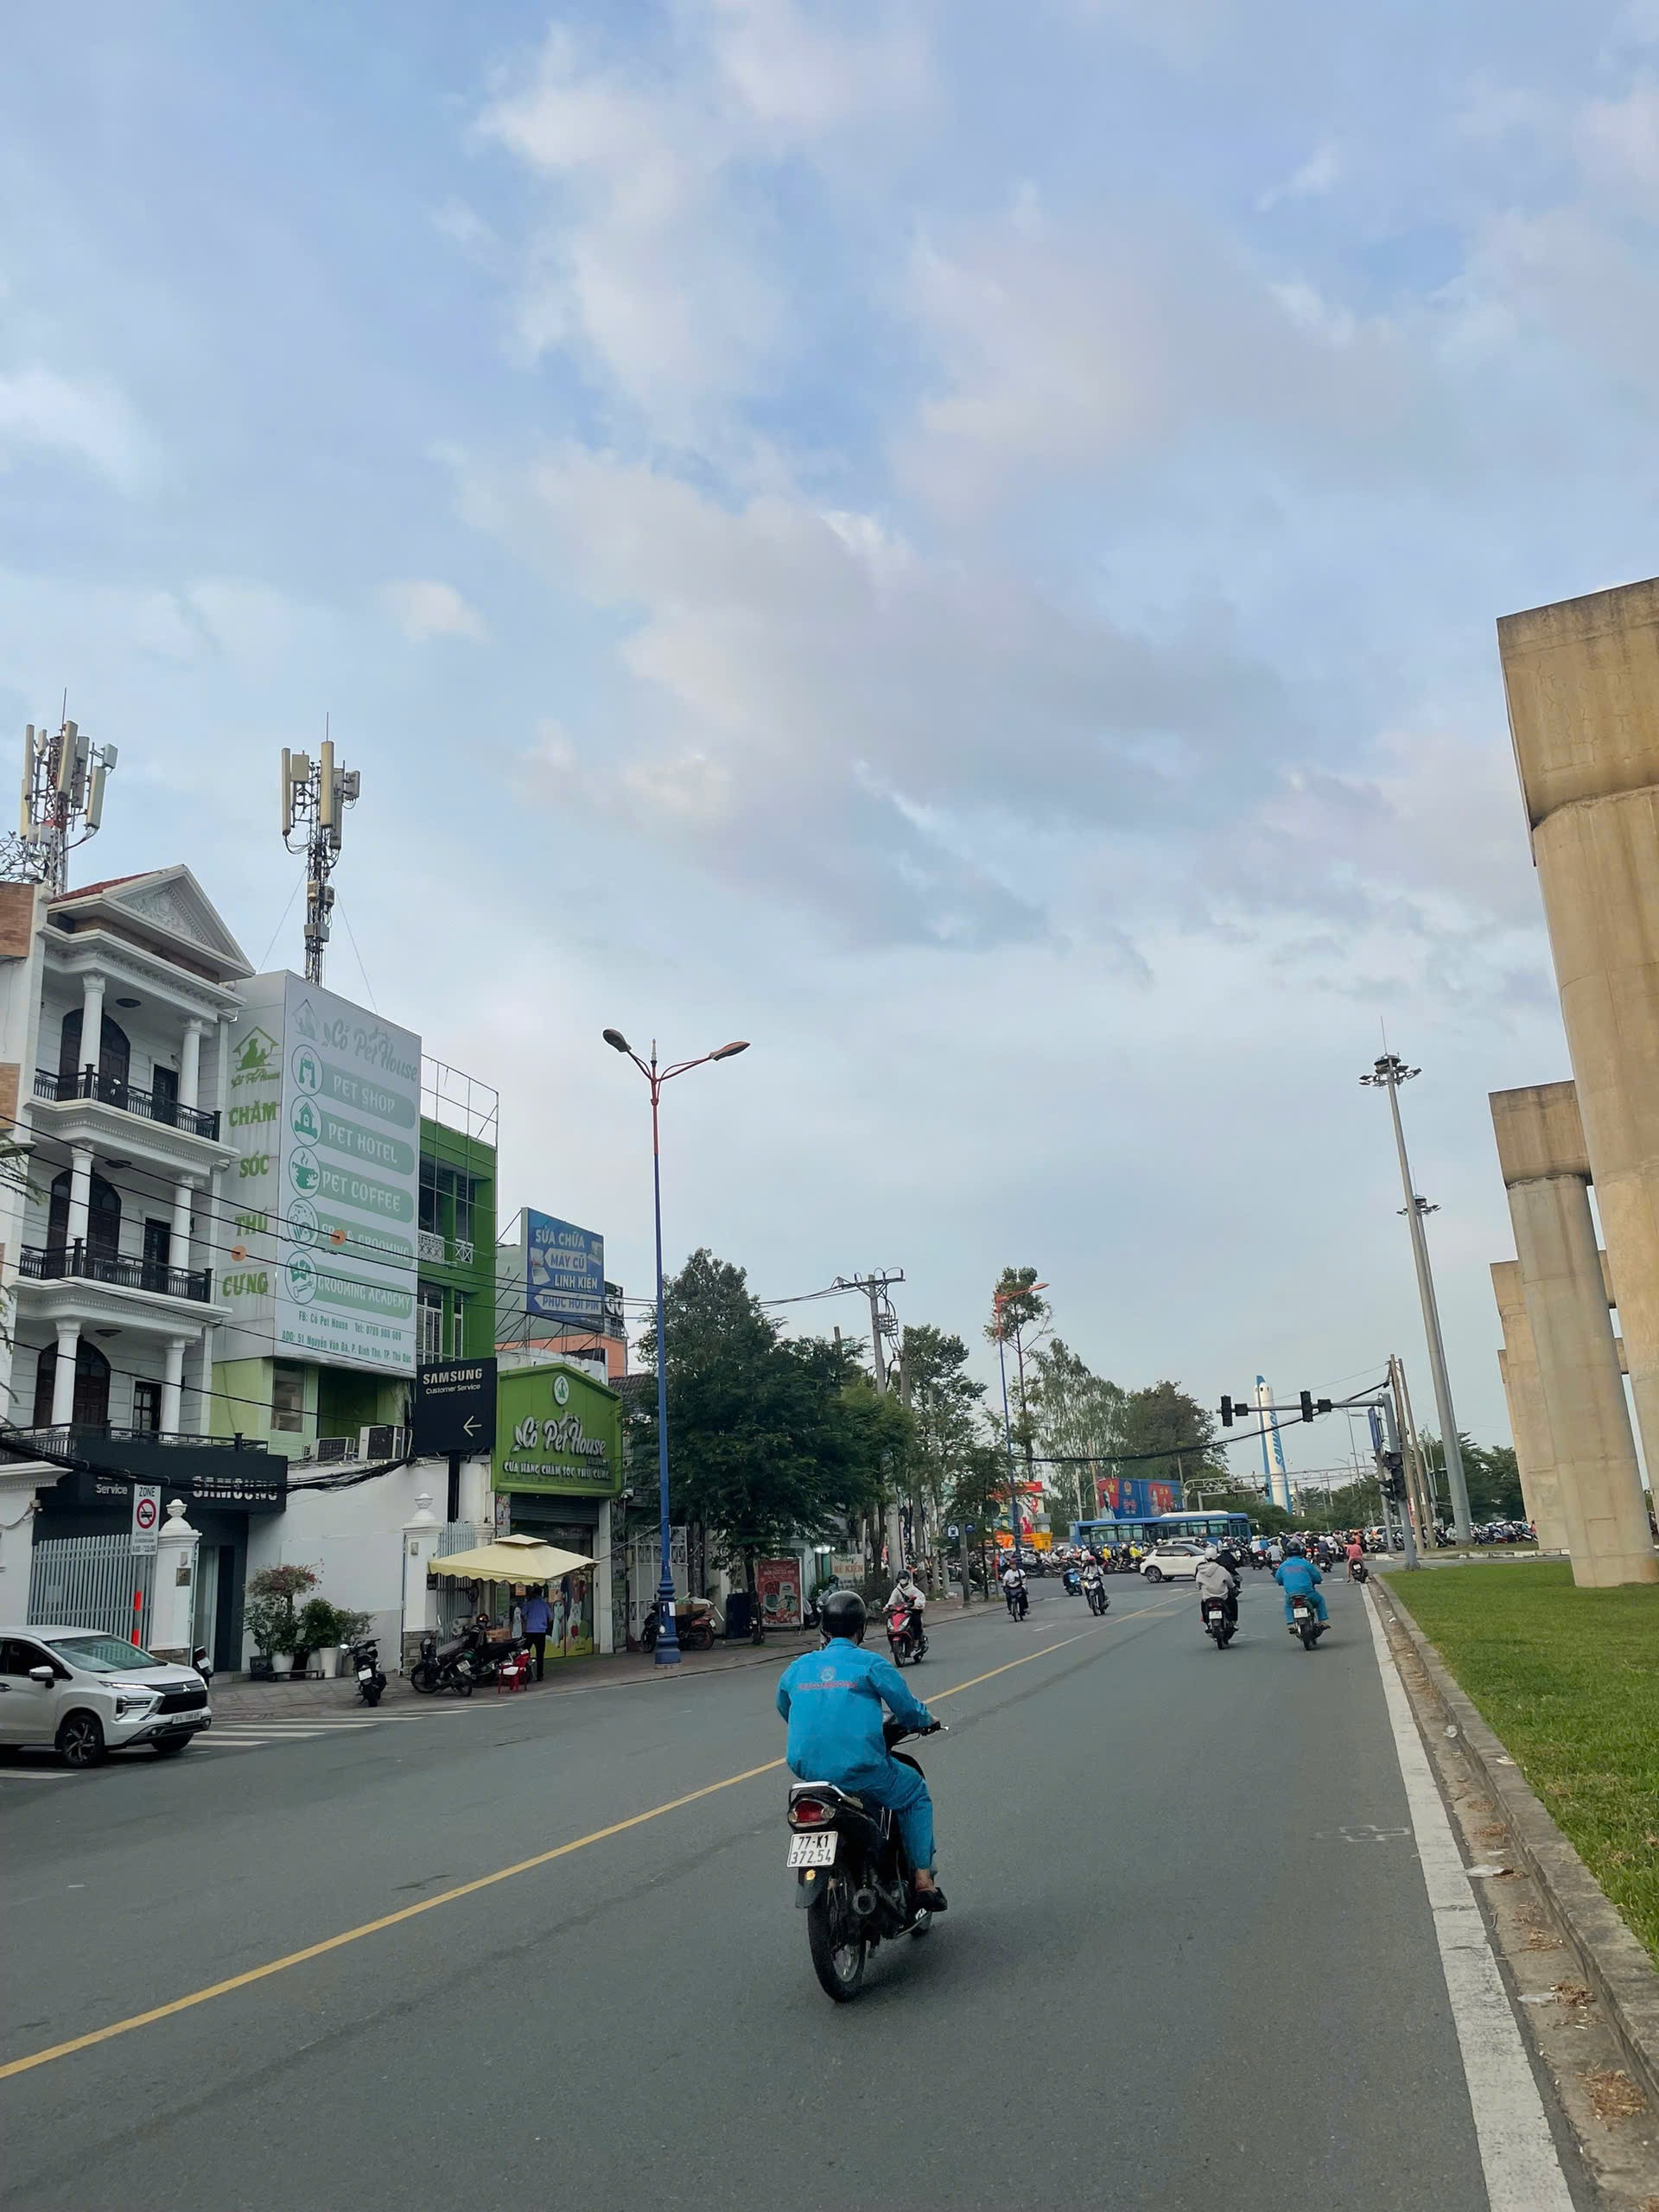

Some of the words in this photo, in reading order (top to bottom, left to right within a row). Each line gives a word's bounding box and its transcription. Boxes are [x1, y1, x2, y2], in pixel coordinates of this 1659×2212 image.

[353, 1027, 378, 1065] Pet
[378, 1038, 417, 1082] House
[333, 1075, 358, 1095] PET
[361, 1086, 395, 1114] SHOP
[229, 1101, 277, 1127] CHĂM
[328, 1122, 353, 1147] PET
[358, 1133, 397, 1163] HOTEL
[239, 1151, 270, 1178] SÓC
[322, 1170, 347, 1192] PET
[352, 1182, 400, 1211] COFFEE
[235, 1207, 268, 1236] THÚ
[359, 1233, 410, 1260] GROOMING
[536, 1225, 556, 1245] SỬA
[558, 1230, 585, 1249] CHỮA
[550, 1251, 570, 1268] MÁY
[573, 1255, 585, 1269] CŨ
[222, 1272, 270, 1297] CƯNG
[318, 1277, 365, 1301] GROOMING
[369, 1288, 410, 1311] ACADEMY
[555, 1274, 575, 1289] LINH
[577, 1274, 598, 1294] KIỆN
[585, 1300, 599, 1311] PIN
[321, 1315, 329, 1326] Pet
[332, 1318, 348, 1331] House
[423, 1368, 483, 1385] SAMSUNG
[425, 1384, 456, 1395] Customer
[456, 1382, 481, 1392] Service
[544, 1419, 568, 1452] Pet
[569, 1422, 606, 1456] House
[96, 1484, 128, 1495] Service
[139, 1486, 156, 1497] ZONE
[798, 1834, 830, 1850] 77-K1
[791, 1849, 831, 1865] 372.54
